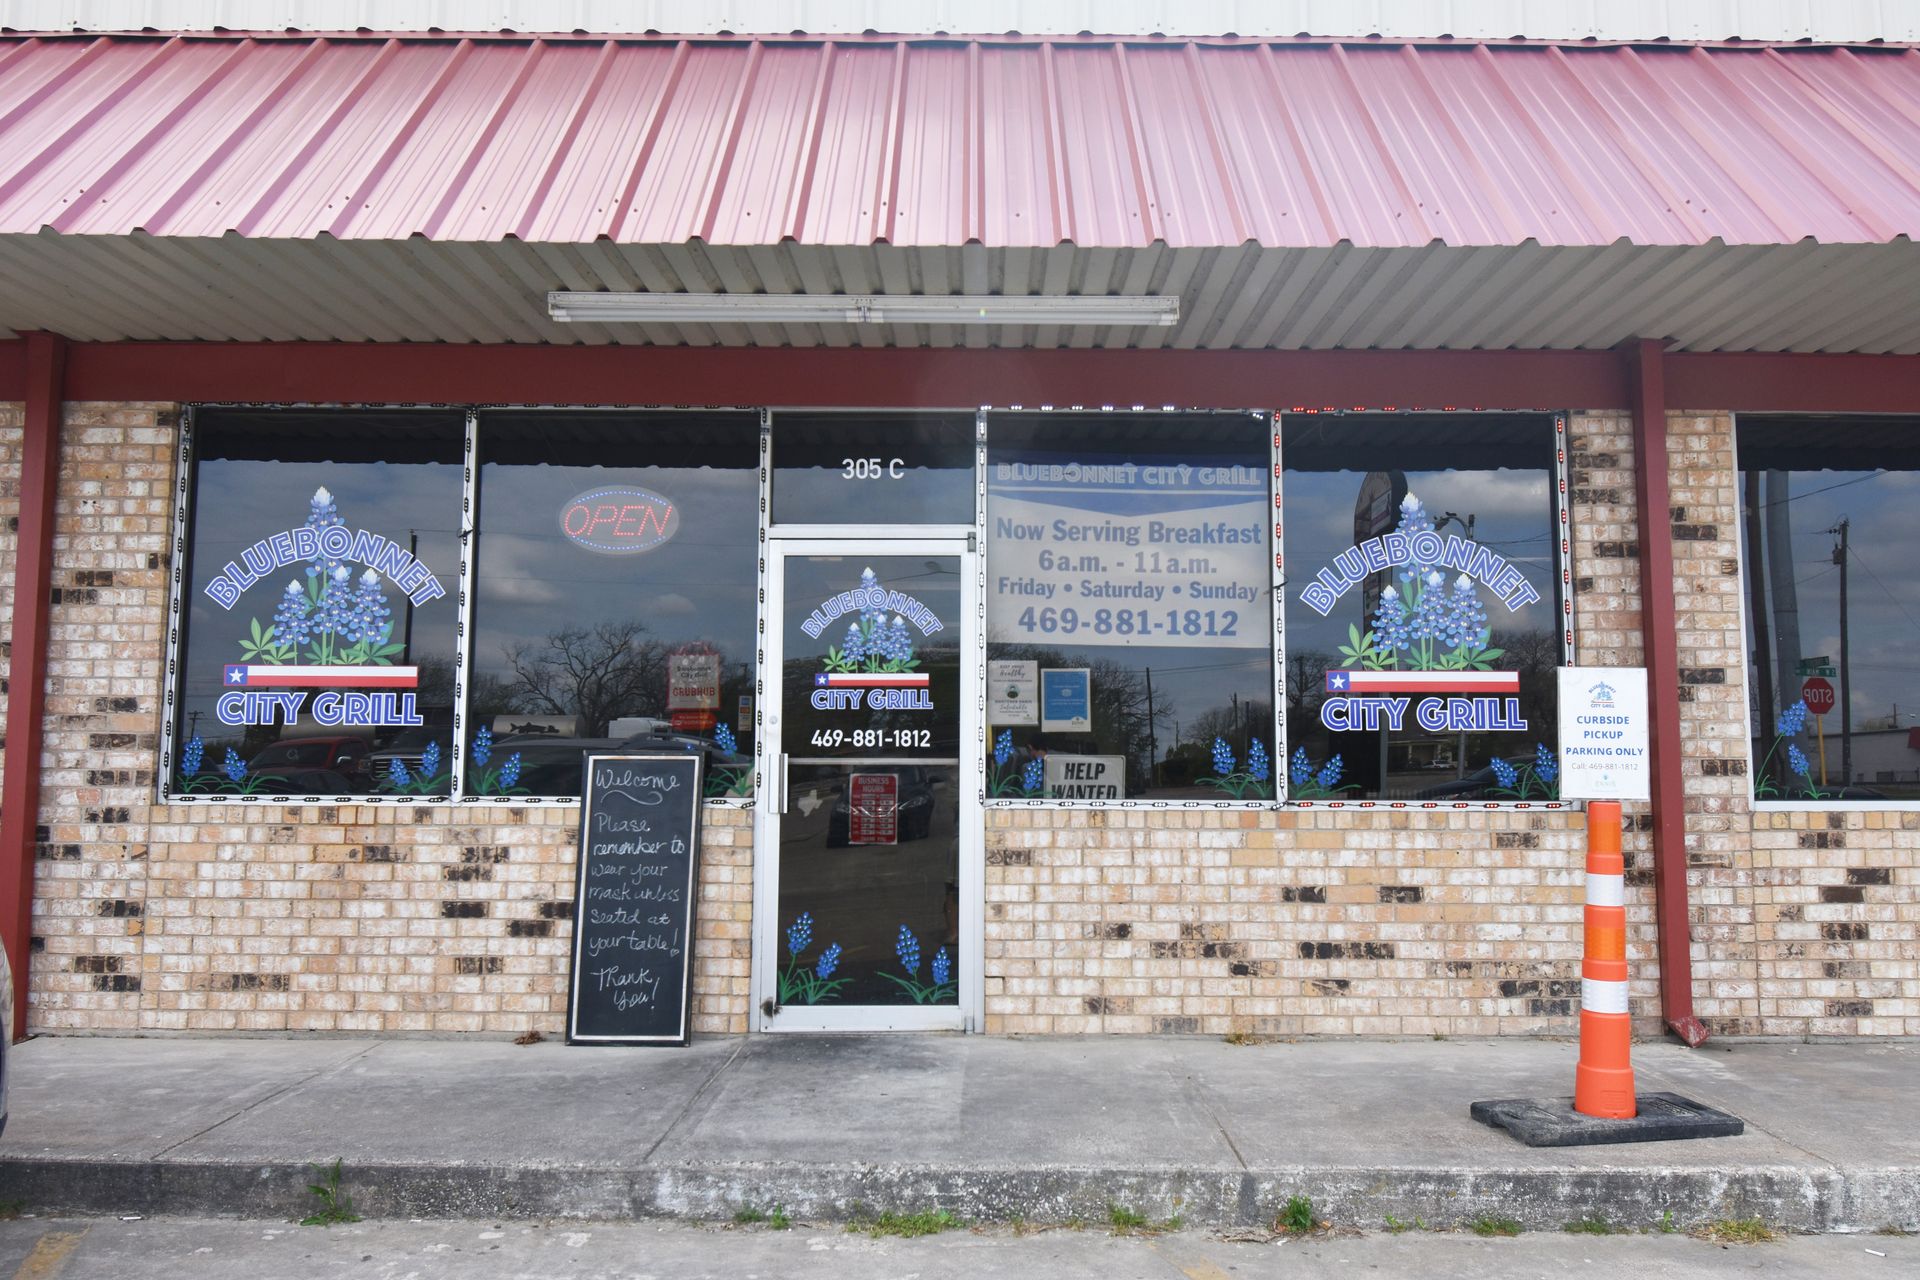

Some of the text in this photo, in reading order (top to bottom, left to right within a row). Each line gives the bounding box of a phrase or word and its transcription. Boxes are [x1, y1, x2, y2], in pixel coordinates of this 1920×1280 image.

[841, 457, 905, 480] 305 C
[996, 462, 1262, 487] BLUEBONNET CITY GRILL
[564, 504, 673, 537] OPEN
[997, 517, 1262, 546] Now Serving Breakfast
[204, 525, 446, 610] BLUEBONNET
[1299, 530, 1541, 617] BLUEBONNET
[998, 576, 1259, 603] Friday Saturday Sunday
[800, 587, 944, 640] BLUEBONNET
[1018, 606, 1239, 637] 469-881-1812
[672, 687, 716, 697] GRUBHUB
[811, 688, 933, 710] CITY GRILL
[216, 691, 423, 726] CITY GRILL
[1320, 697, 1528, 731] CITY GRILL
[1576, 715, 1630, 725] CURBSIDE
[811, 729, 931, 748] 469-881-1812
[1583, 730, 1624, 739] PICKUP
[1566, 747, 1644, 756] PARKING ONLY
[1064, 762, 1107, 781] HELP
[1588, 763, 1639, 771] 469-881-1812
[595, 769, 680, 791] Welcome
[858, 776, 889, 785] BUSINESS
[862, 785, 884, 793] HOURS
[1051, 784, 1118, 800] WANTED
[594, 812, 651, 832] Please
[593, 835, 685, 856] remember to
[591, 863, 668, 885] wear your
[589, 882, 680, 902] mask unless
[647, 913, 671, 925] at
[588, 934, 627, 957] your
[590, 965, 653, 991] Thank
